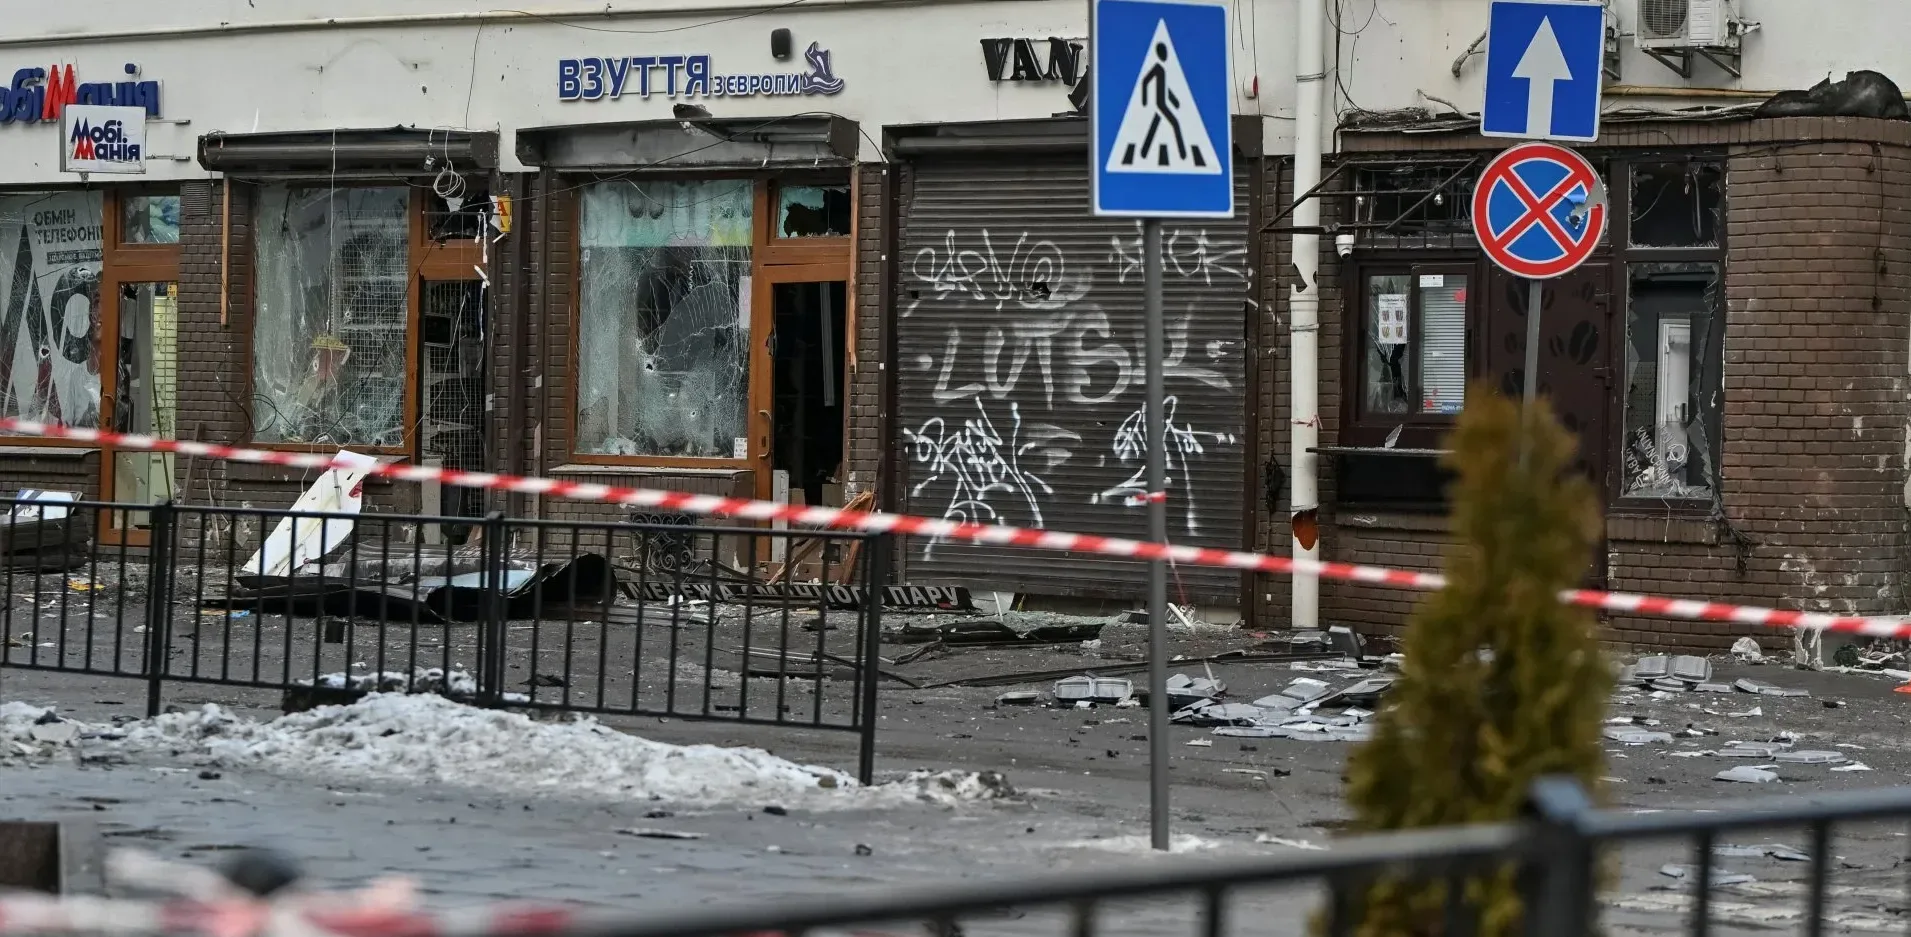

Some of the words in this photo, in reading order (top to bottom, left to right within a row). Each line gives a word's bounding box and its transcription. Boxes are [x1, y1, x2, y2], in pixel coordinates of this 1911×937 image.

[558, 54, 711, 100] ВЗУТТЯ
[73, 138, 141, 161] Манія
[34, 209, 76, 226] ОБМІН
[888, 586, 958, 606] ПАРУ
